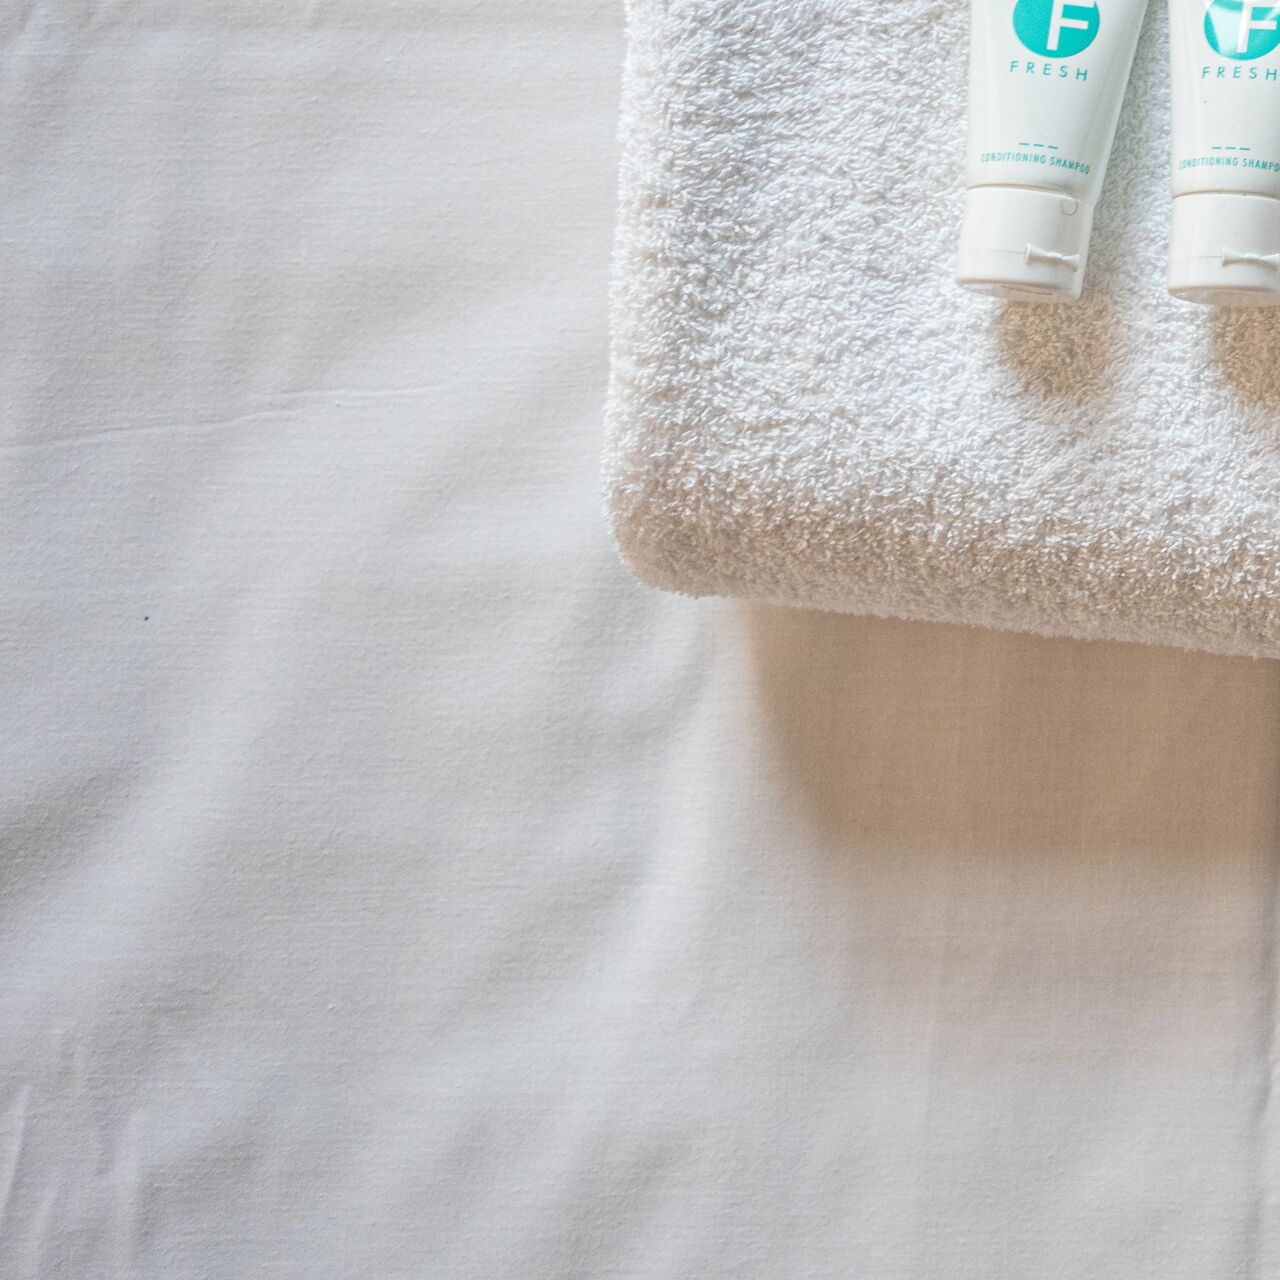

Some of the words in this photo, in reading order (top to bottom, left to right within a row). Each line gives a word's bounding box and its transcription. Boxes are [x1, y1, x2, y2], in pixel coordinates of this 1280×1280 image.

[1009, 60, 1088, 81] FRESH
[1201, 65, 1278, 81] FRESH
[980, 152, 1046, 165] CONDITIONING
[1049, 156, 1091, 175] SHAMPOO
[1178, 157, 1239, 169] CONDITIONING
